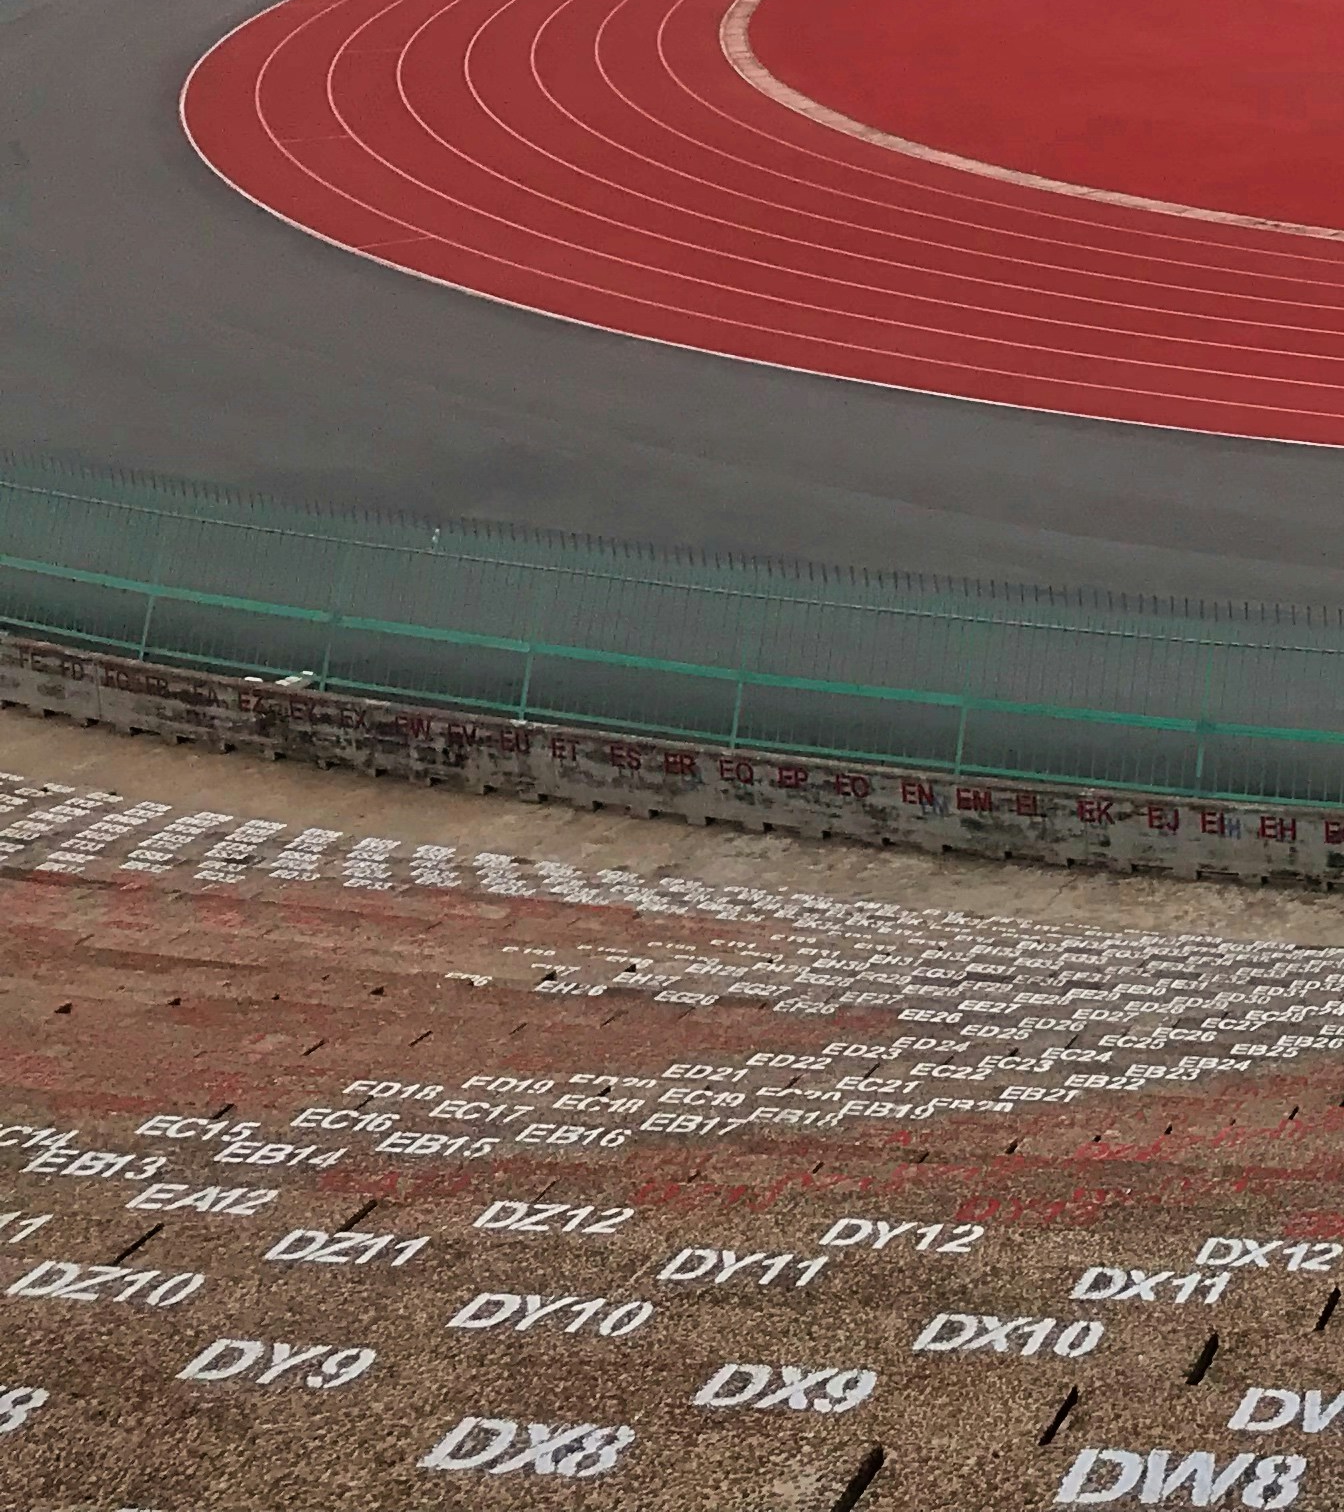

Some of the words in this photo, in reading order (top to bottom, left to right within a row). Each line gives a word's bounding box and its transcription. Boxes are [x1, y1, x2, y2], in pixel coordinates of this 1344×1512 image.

[552, 736, 580, 760] ET
[610, 744, 642, 770] ES
[719, 759, 754, 787] EQ
[902, 782, 934, 805] EN
[956, 788, 993, 812] EM
[1077, 800, 1114, 822] EK
[1148, 807, 1180, 835] EJ
[1201, 812, 1225, 835] EI
[1260, 815, 1296, 842] EH
[960, 1024, 1034, 1041] ED25
[1017, 1017, 1087, 1032] ED26
[823, 1042, 903, 1060] ED23
[892, 1037, 972, 1053] ED24
[1040, 1047, 1113, 1063] EC24
[1097, 1035, 1167, 1050] EC25
[662, 1064, 749, 1083] ED21
[746, 1053, 832, 1070] ED22
[910, 1063, 993, 1081] EC22
[977, 1056, 1055, 1072] EC23
[836, 1076, 921, 1094] EC21
[999, 1086, 1086, 1103] EB21
[1063, 1074, 1148, 1091] EB22
[136, 1115, 260, 1142] EC15
[291, 1108, 399, 1131] EC16
[641, 1113, 751, 1136] EB17
[515, 1124, 631, 1148] EB16
[21, 1148, 167, 1179] EB13
[214, 1142, 348, 1167] EB14
[126, 1183, 277, 1215] EA12
[472, 1200, 635, 1234] DZ12
[264, 1230, 430, 1266] DZ11
[819, 1218, 984, 1253] DY12
[1195, 1237, 1342, 1271] DX12
[656, 1248, 830, 1288] DY11
[7, 1261, 205, 1307] DZ10
[1069, 1266, 1233, 1305] DX11
[446, 1292, 653, 1336] DY10
[912, 1312, 1105, 1358] DX10
[176, 1337, 377, 1388] DY9
[694, 1363, 879, 1413] DX9
[417, 1417, 636, 1478] DX8
[1053, 1448, 1308, 1509] DW8
